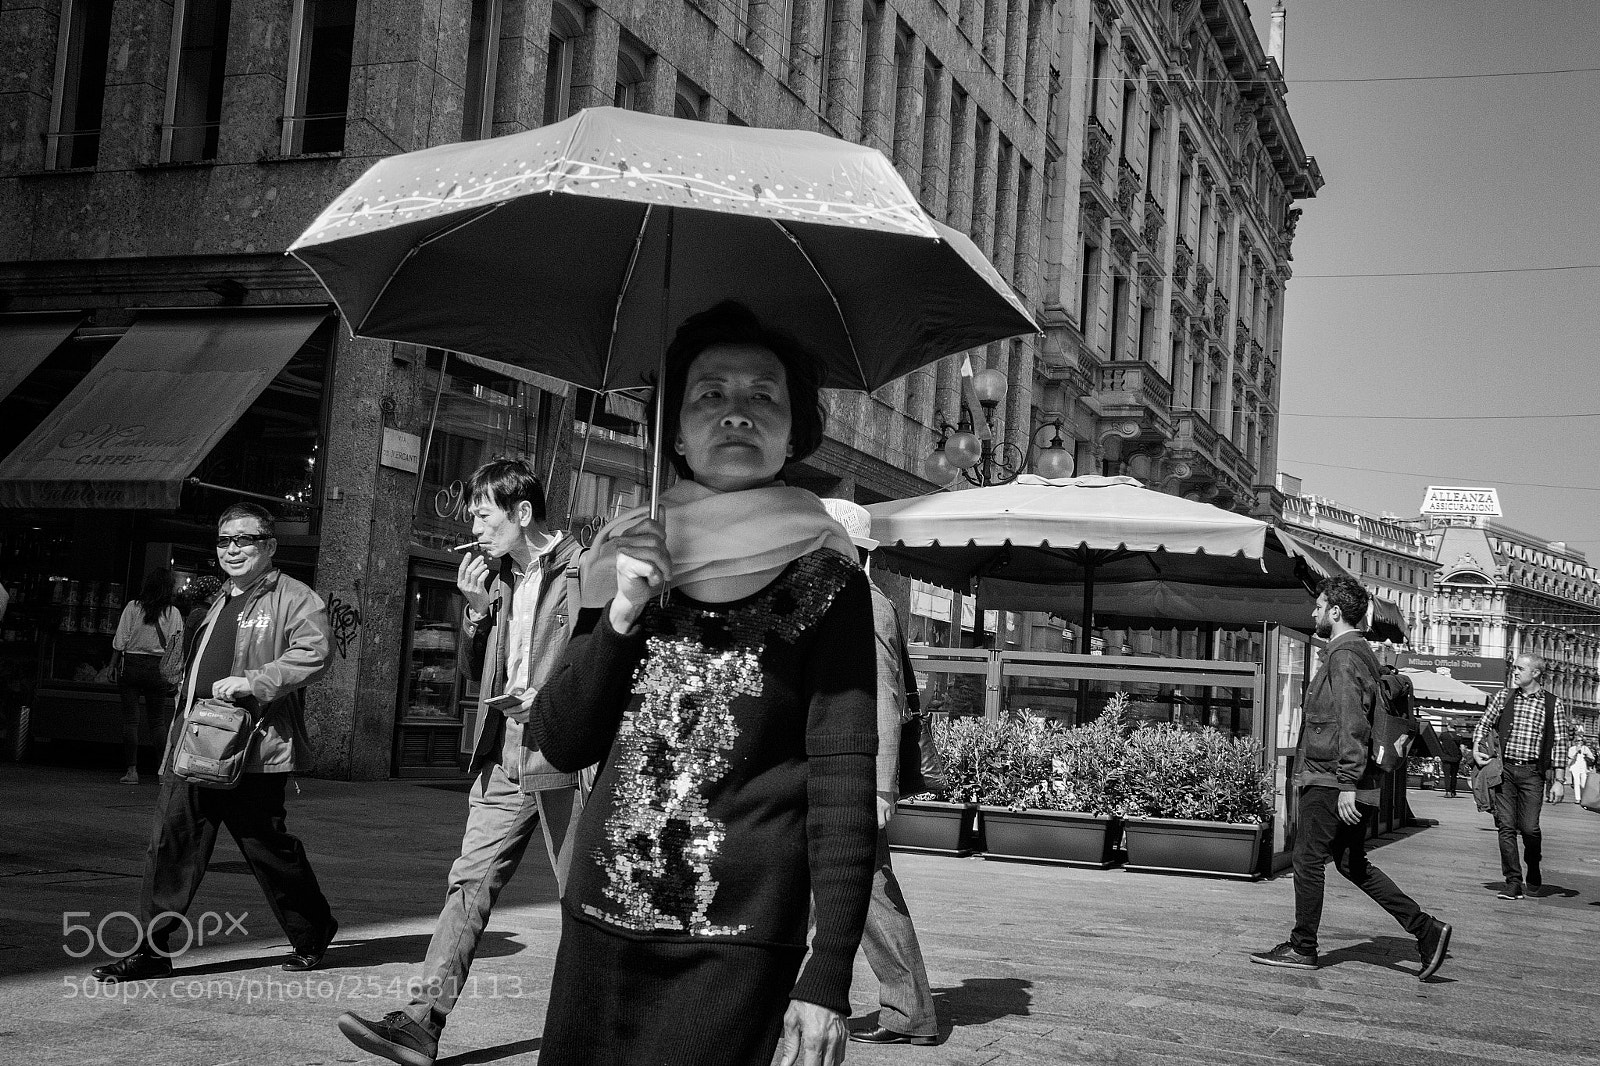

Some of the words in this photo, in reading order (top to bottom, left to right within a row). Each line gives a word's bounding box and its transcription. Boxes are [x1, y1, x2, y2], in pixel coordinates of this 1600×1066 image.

[1430, 492, 1494, 503] ALLEANZA
[1429, 502, 1494, 512] ASSICURAZIONI
[1408, 658, 1433, 667] Milano
[1434, 659, 1460, 668] Official
[1461, 660, 1482, 668] Store
